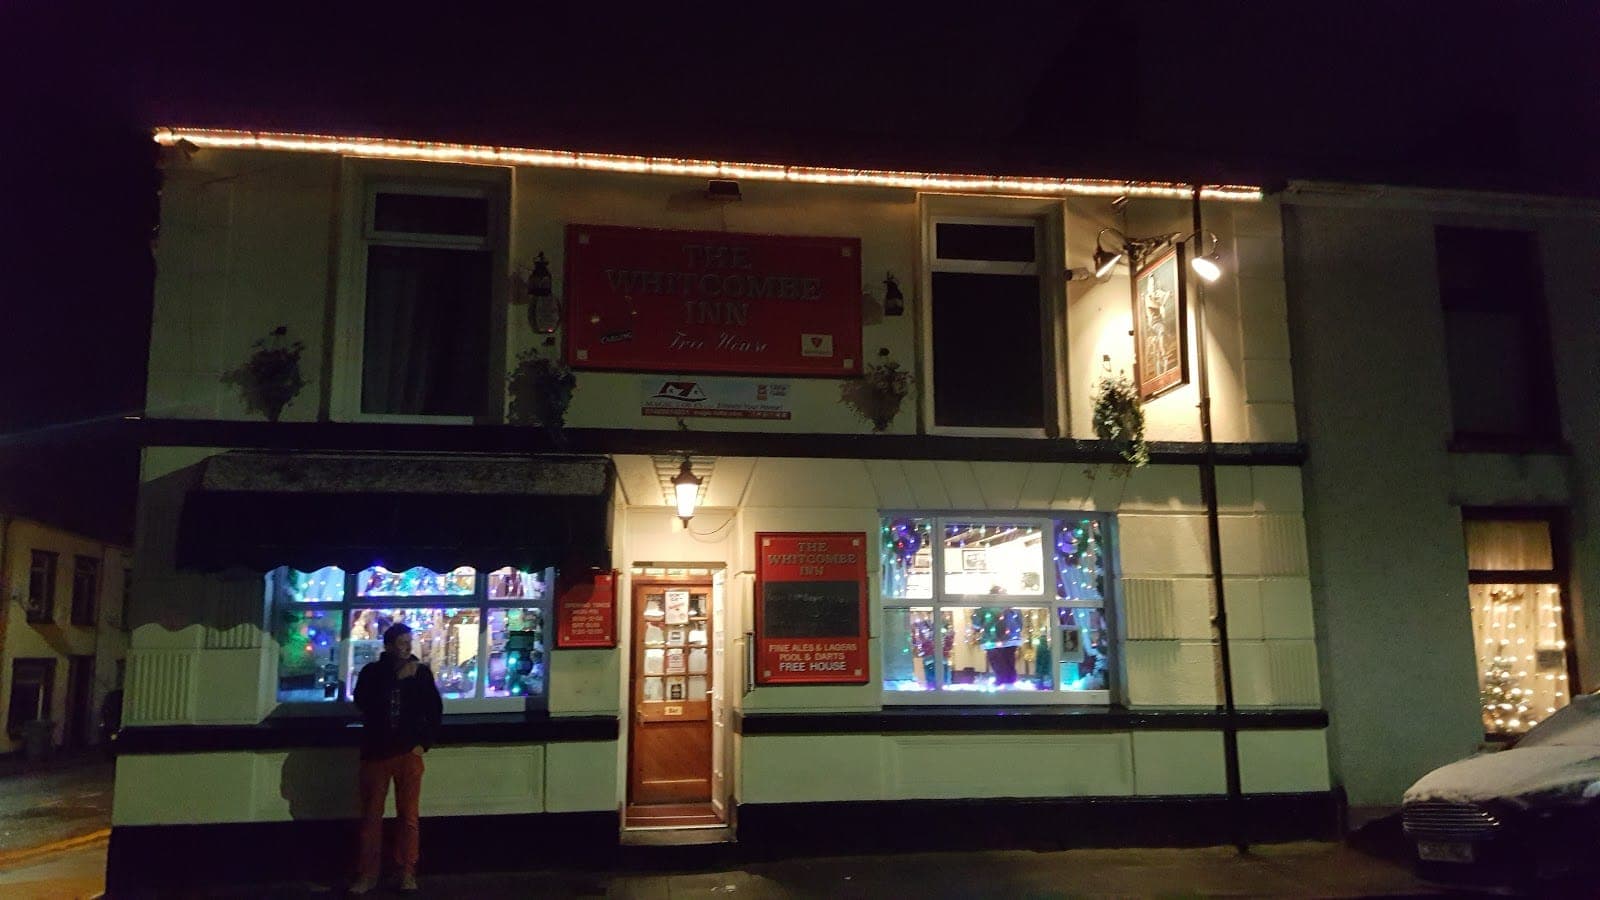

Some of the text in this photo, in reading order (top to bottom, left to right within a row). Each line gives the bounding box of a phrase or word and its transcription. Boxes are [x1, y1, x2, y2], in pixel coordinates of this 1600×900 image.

[682, 244, 752, 269] THE
[605, 268, 823, 301] WHITCOMBE
[684, 300, 750, 326] INN
[798, 542, 828, 552] THE
[767, 553, 857, 565] WHITCOMBE
[799, 566, 825, 576] INN
[768, 643, 857, 653] FINE ALES & LAGERS
[779, 652, 846, 661] POOL & DARTS
[779, 661, 847, 672] FREE HOUSE
